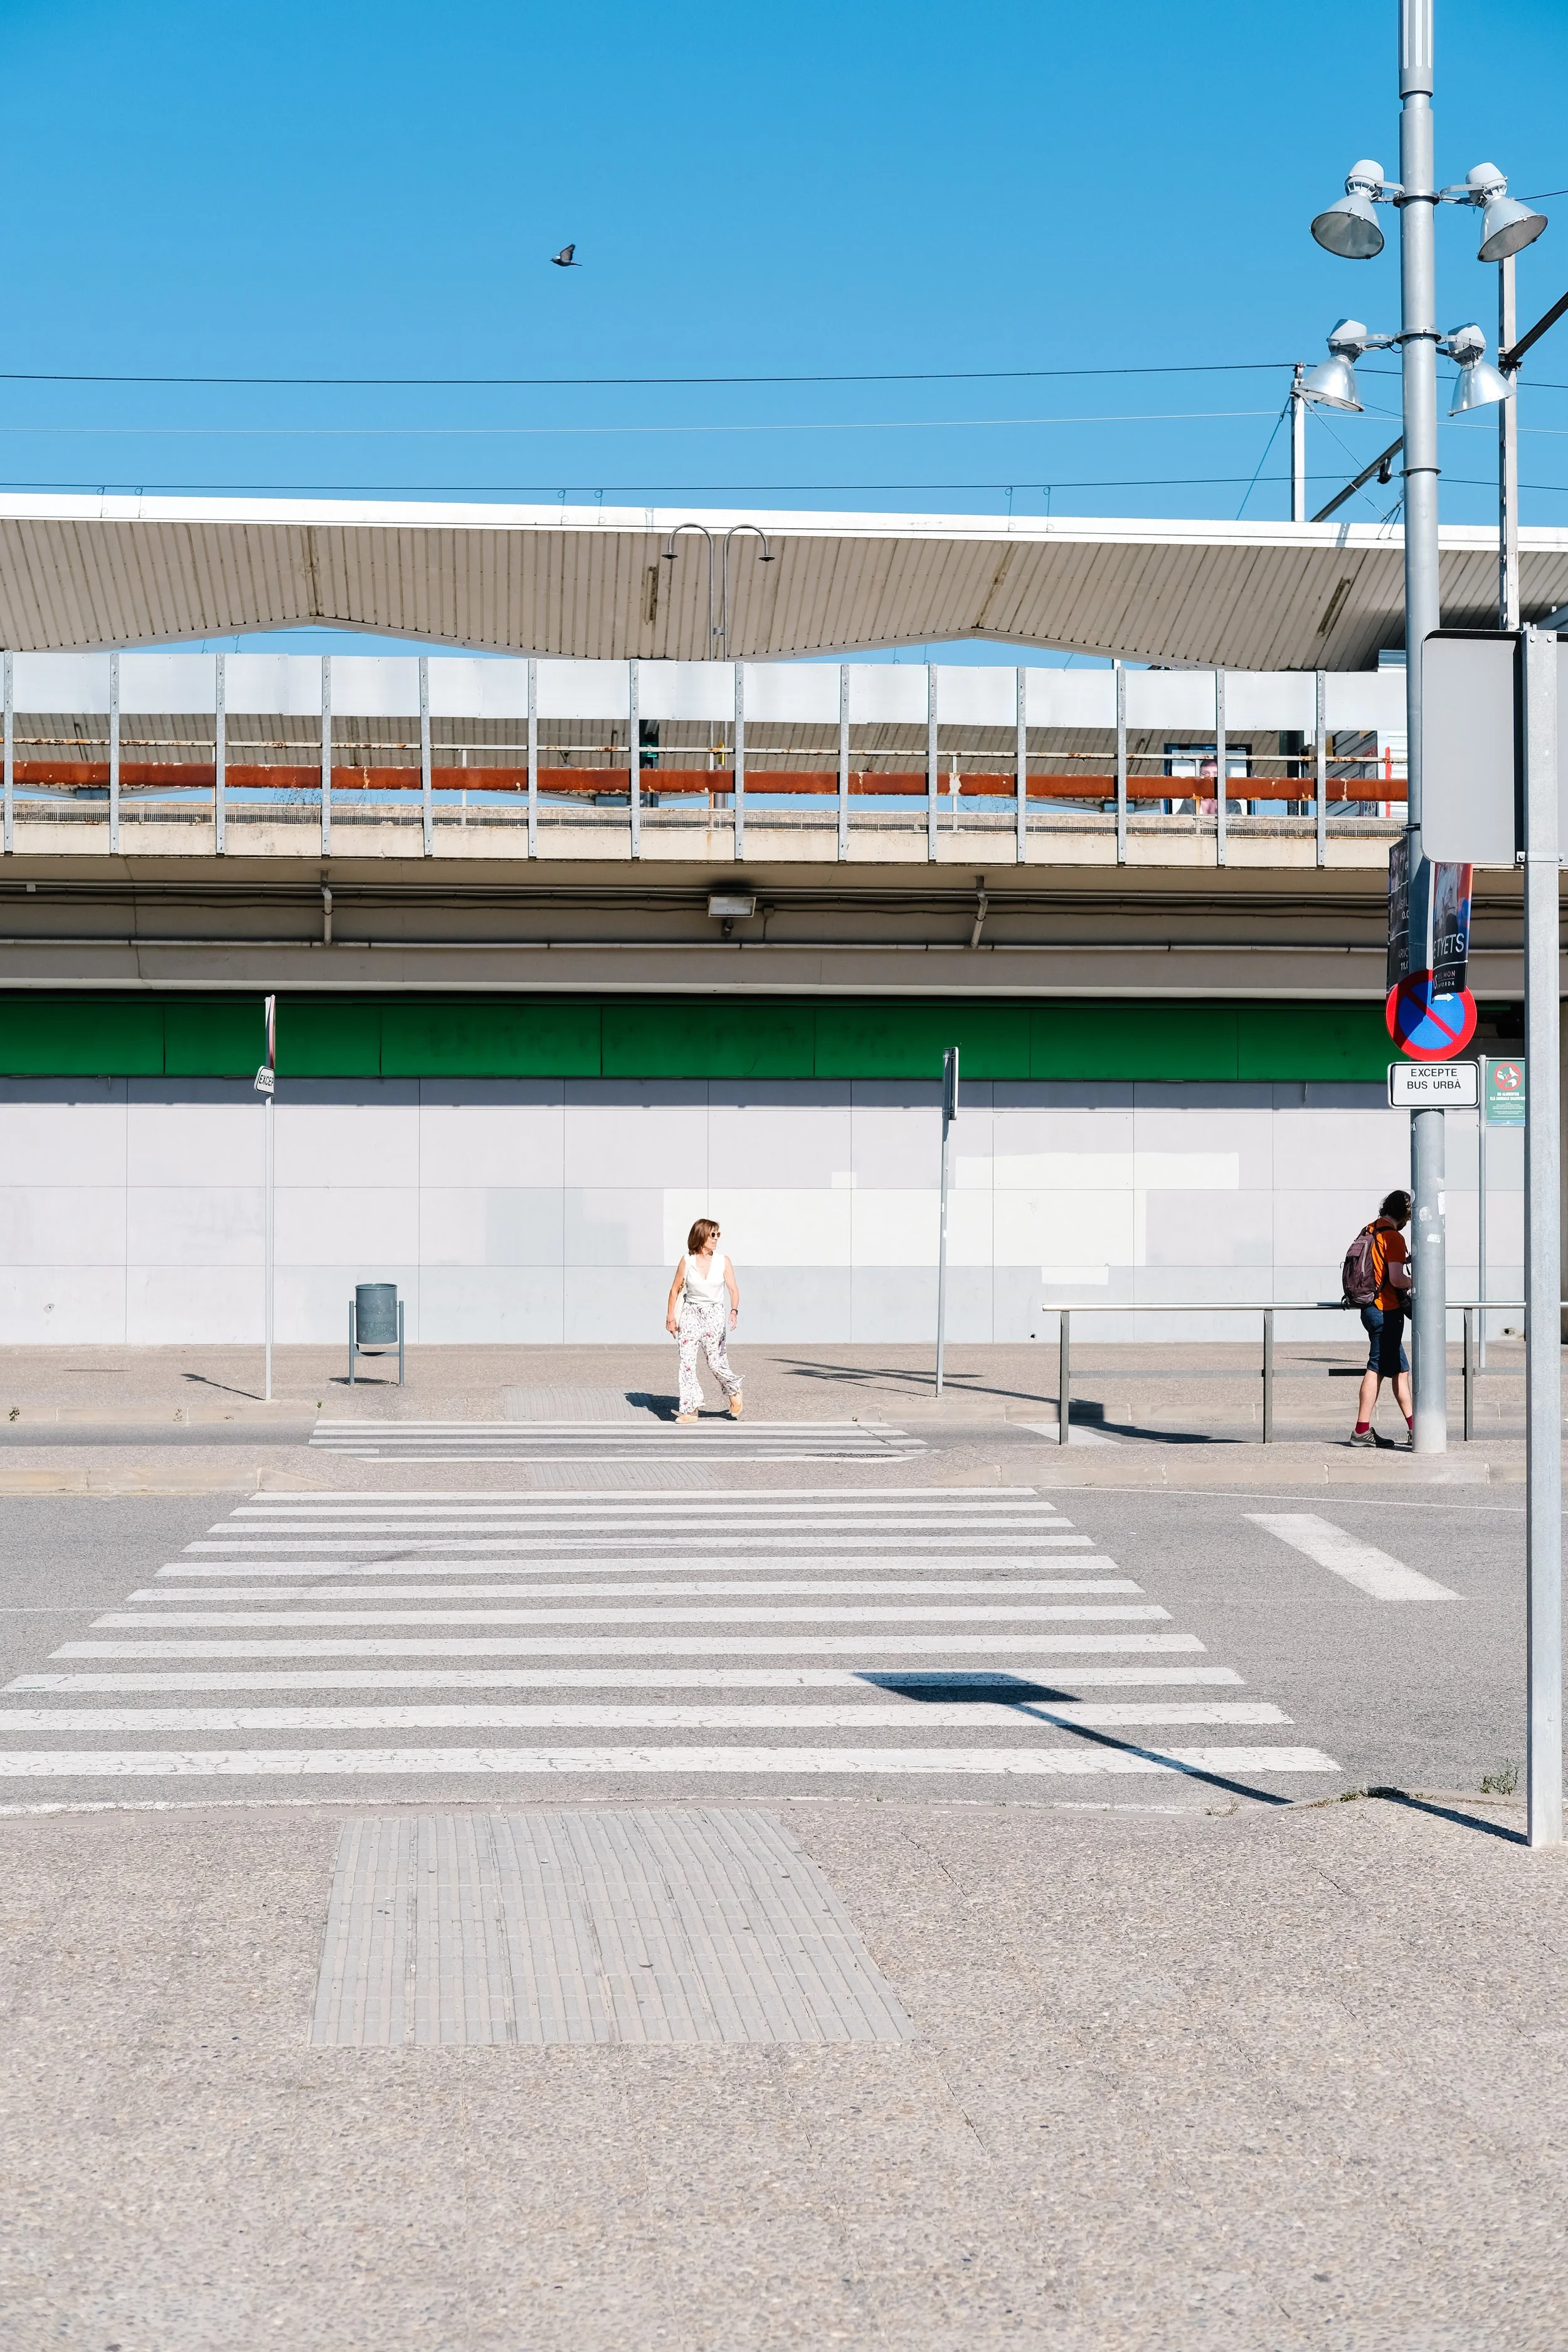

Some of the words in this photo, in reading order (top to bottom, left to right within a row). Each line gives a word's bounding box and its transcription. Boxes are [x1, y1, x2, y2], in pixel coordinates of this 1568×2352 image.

[1411, 1068, 1458, 1077] EXCEPTE
[1407, 1081, 1428, 1089] BUS
[1433, 1079, 1461, 1089] URBÀ
